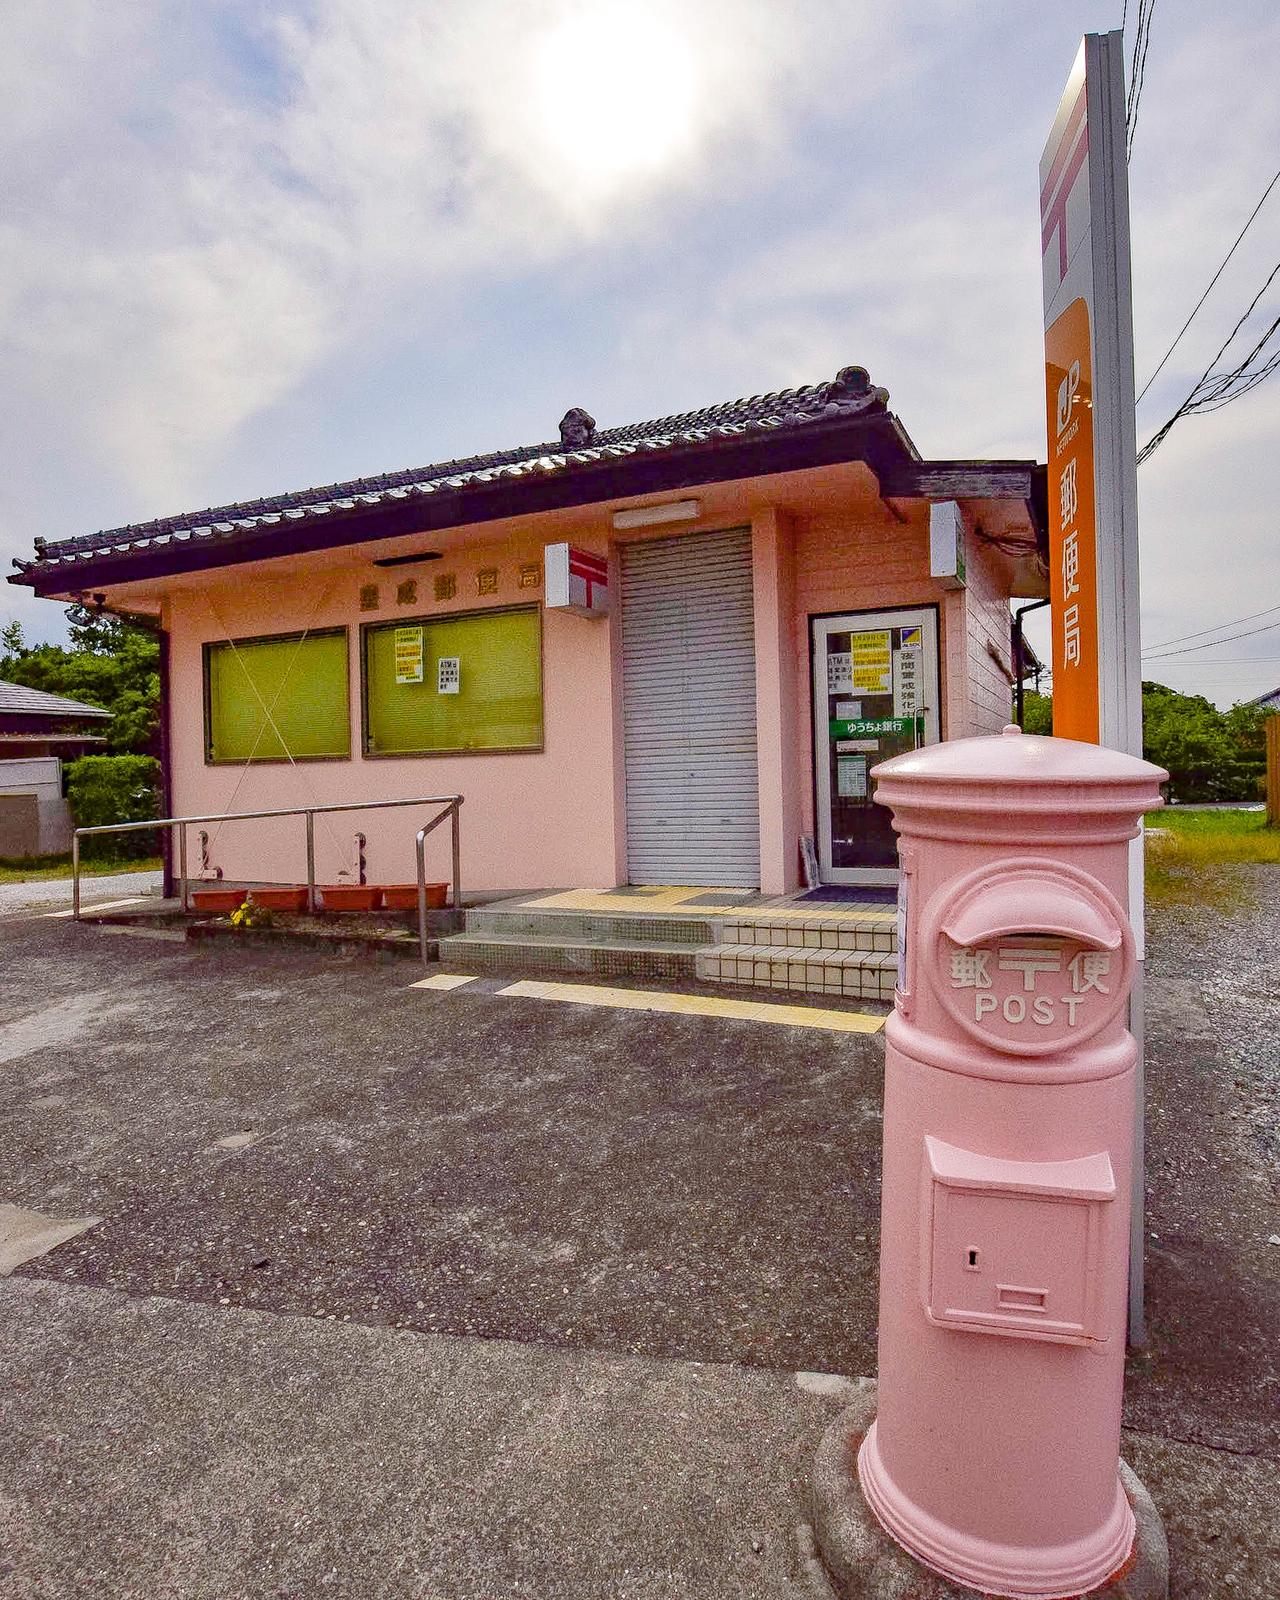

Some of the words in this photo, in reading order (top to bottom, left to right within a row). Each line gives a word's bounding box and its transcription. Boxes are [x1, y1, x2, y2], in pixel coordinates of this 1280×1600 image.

[1060, 457, 1081, 670] 郵便局
[847, 720, 904, 733] ゆうちょ銀行
[974, 993, 1085, 1027] POST
